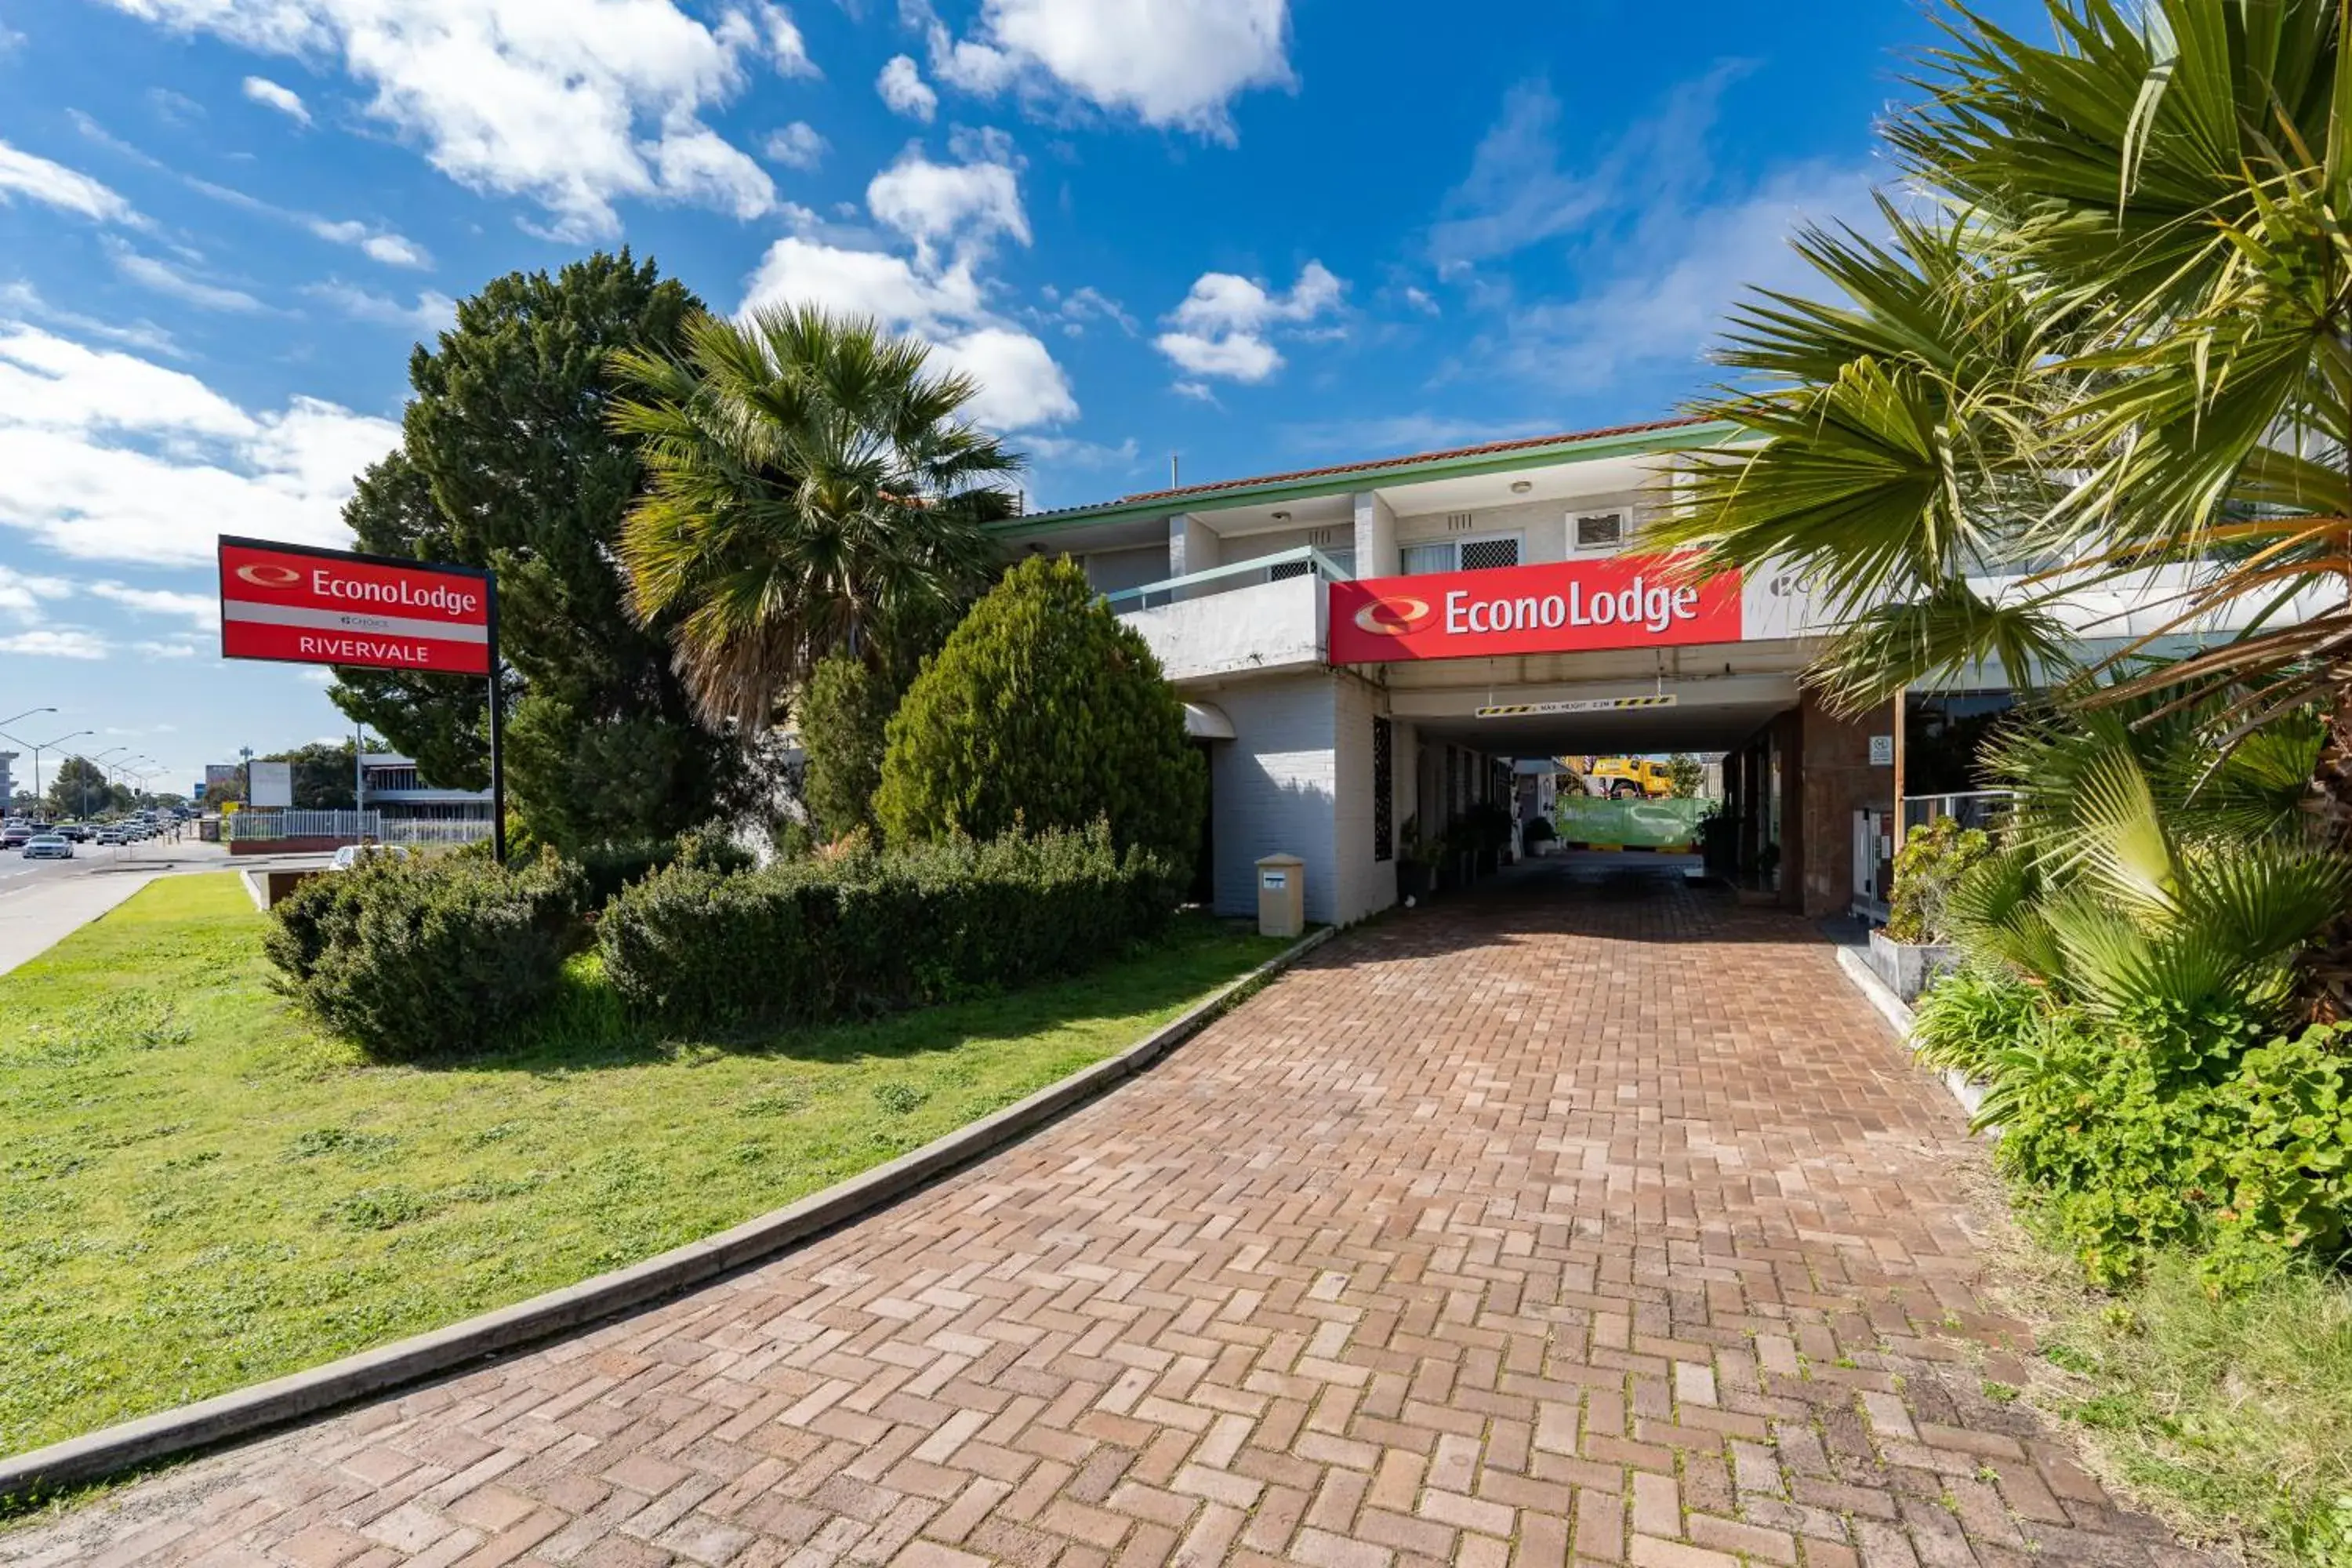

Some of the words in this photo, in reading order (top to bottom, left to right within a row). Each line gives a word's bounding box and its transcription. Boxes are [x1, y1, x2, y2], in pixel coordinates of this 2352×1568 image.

[313, 569, 477, 615] EconoLodge
[1445, 576, 1698, 633] EconoLodge
[300, 637, 429, 662] RIVERVALE
